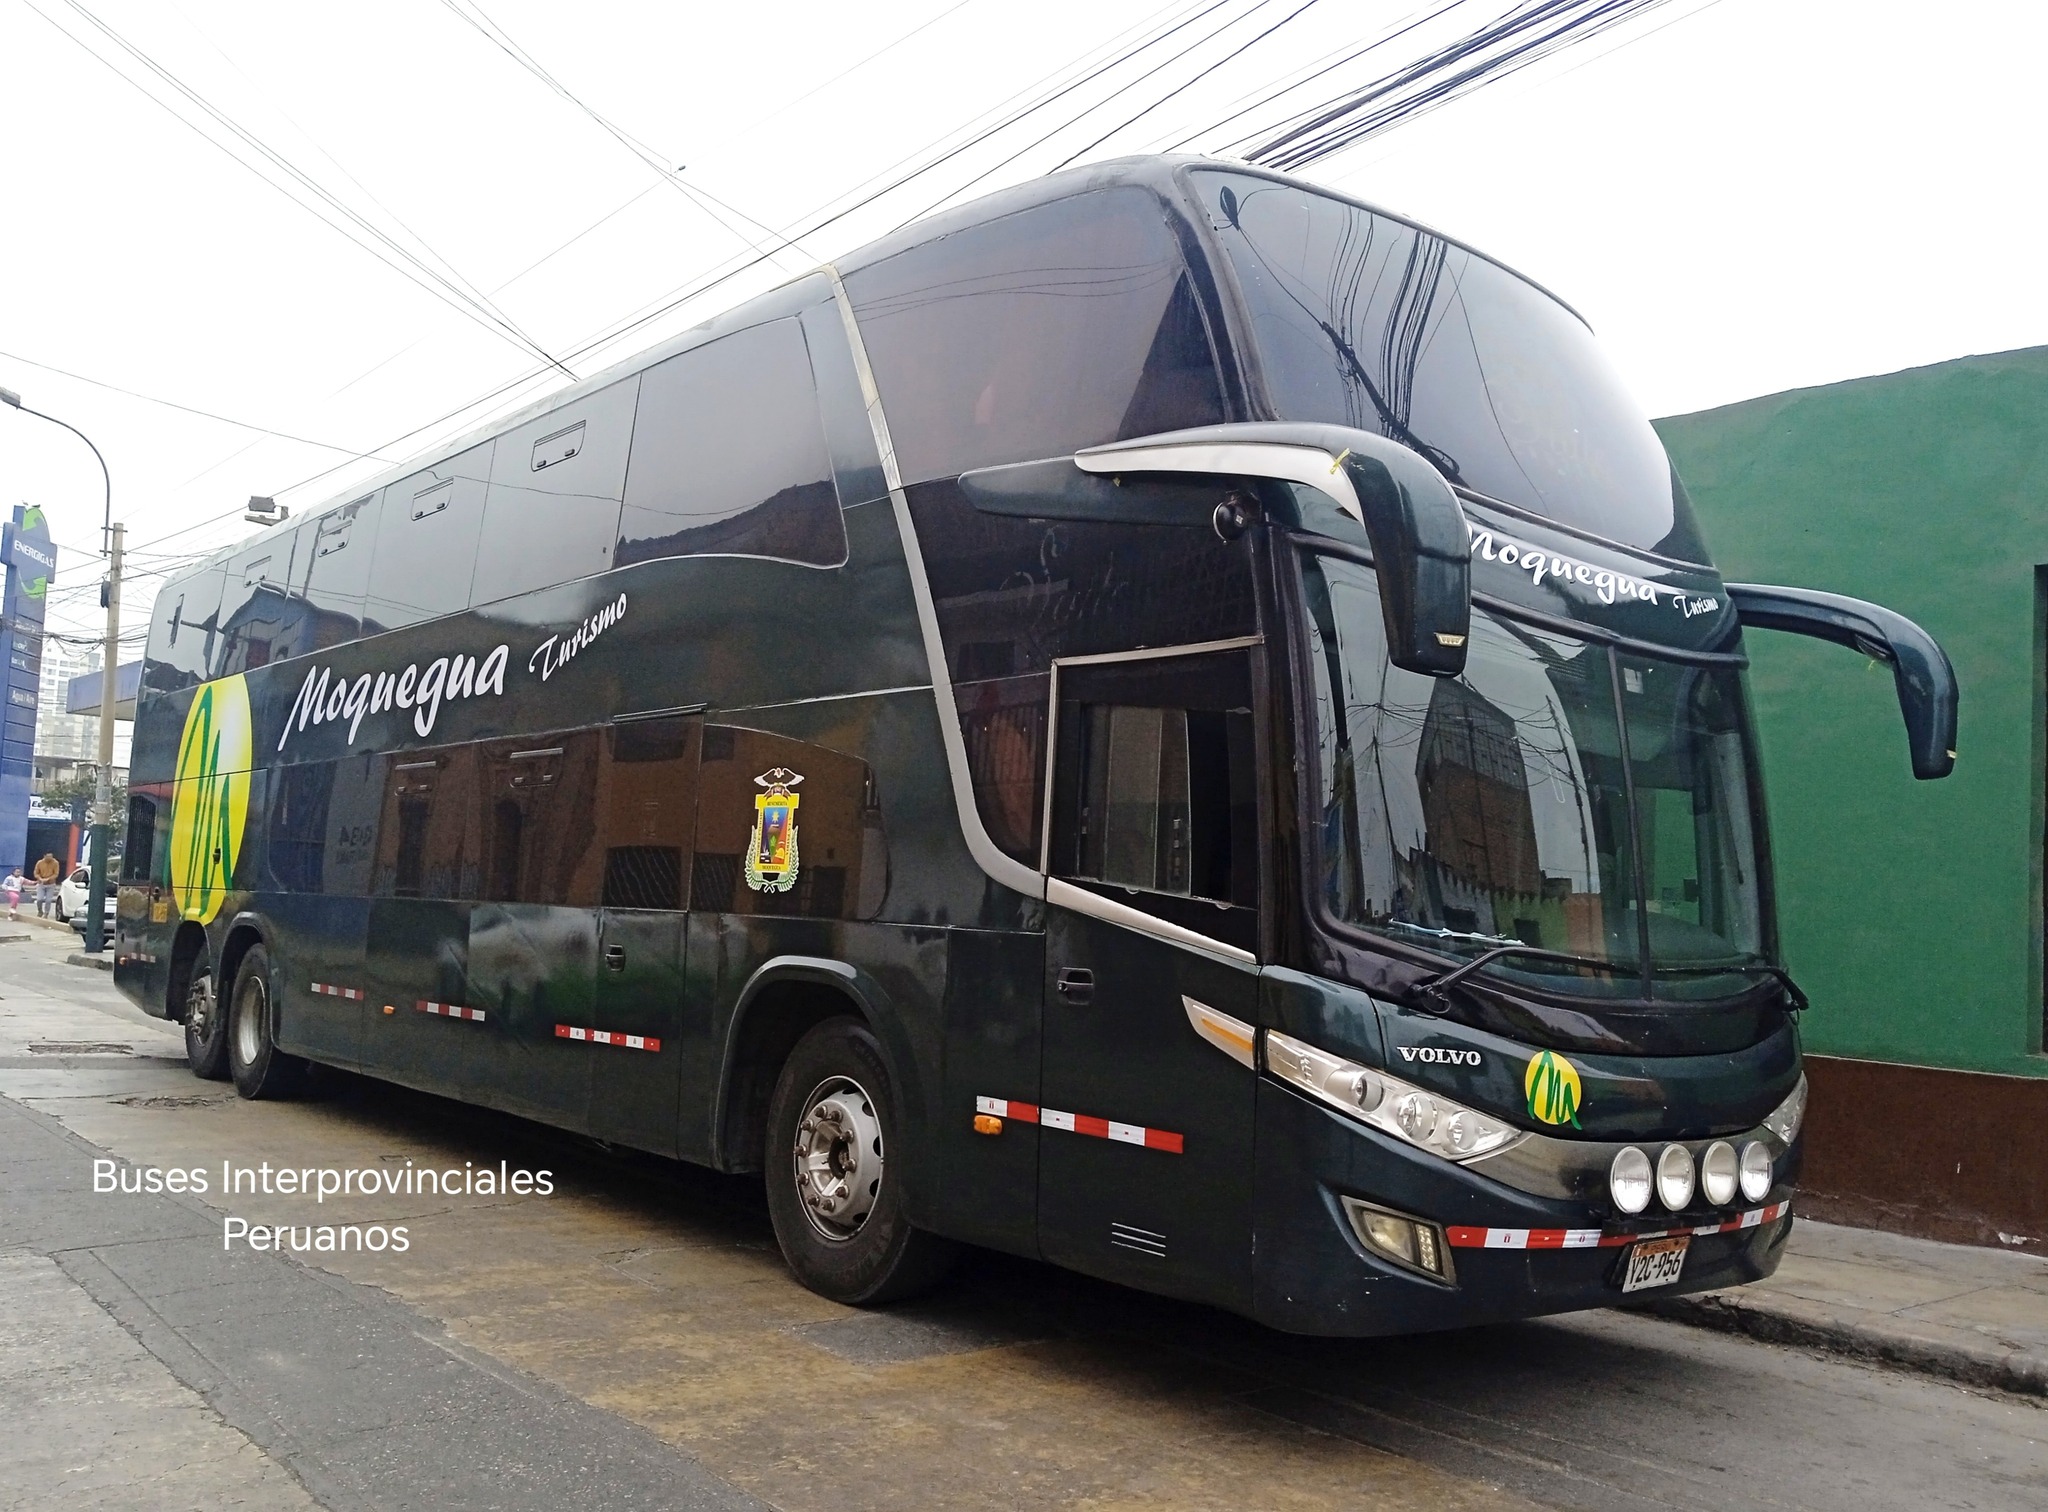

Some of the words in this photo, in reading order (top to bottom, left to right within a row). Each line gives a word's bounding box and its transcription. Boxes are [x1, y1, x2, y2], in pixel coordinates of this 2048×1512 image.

[14, 539, 54, 568] ENERGIGAS
[1673, 595, 1719, 619] Turismo
[277, 644, 509, 752] Moquegua
[528, 592, 628, 682] Turismo
[1397, 1046, 1482, 1066] VOLVO
[1629, 1249, 1683, 1285] Y2C-956
